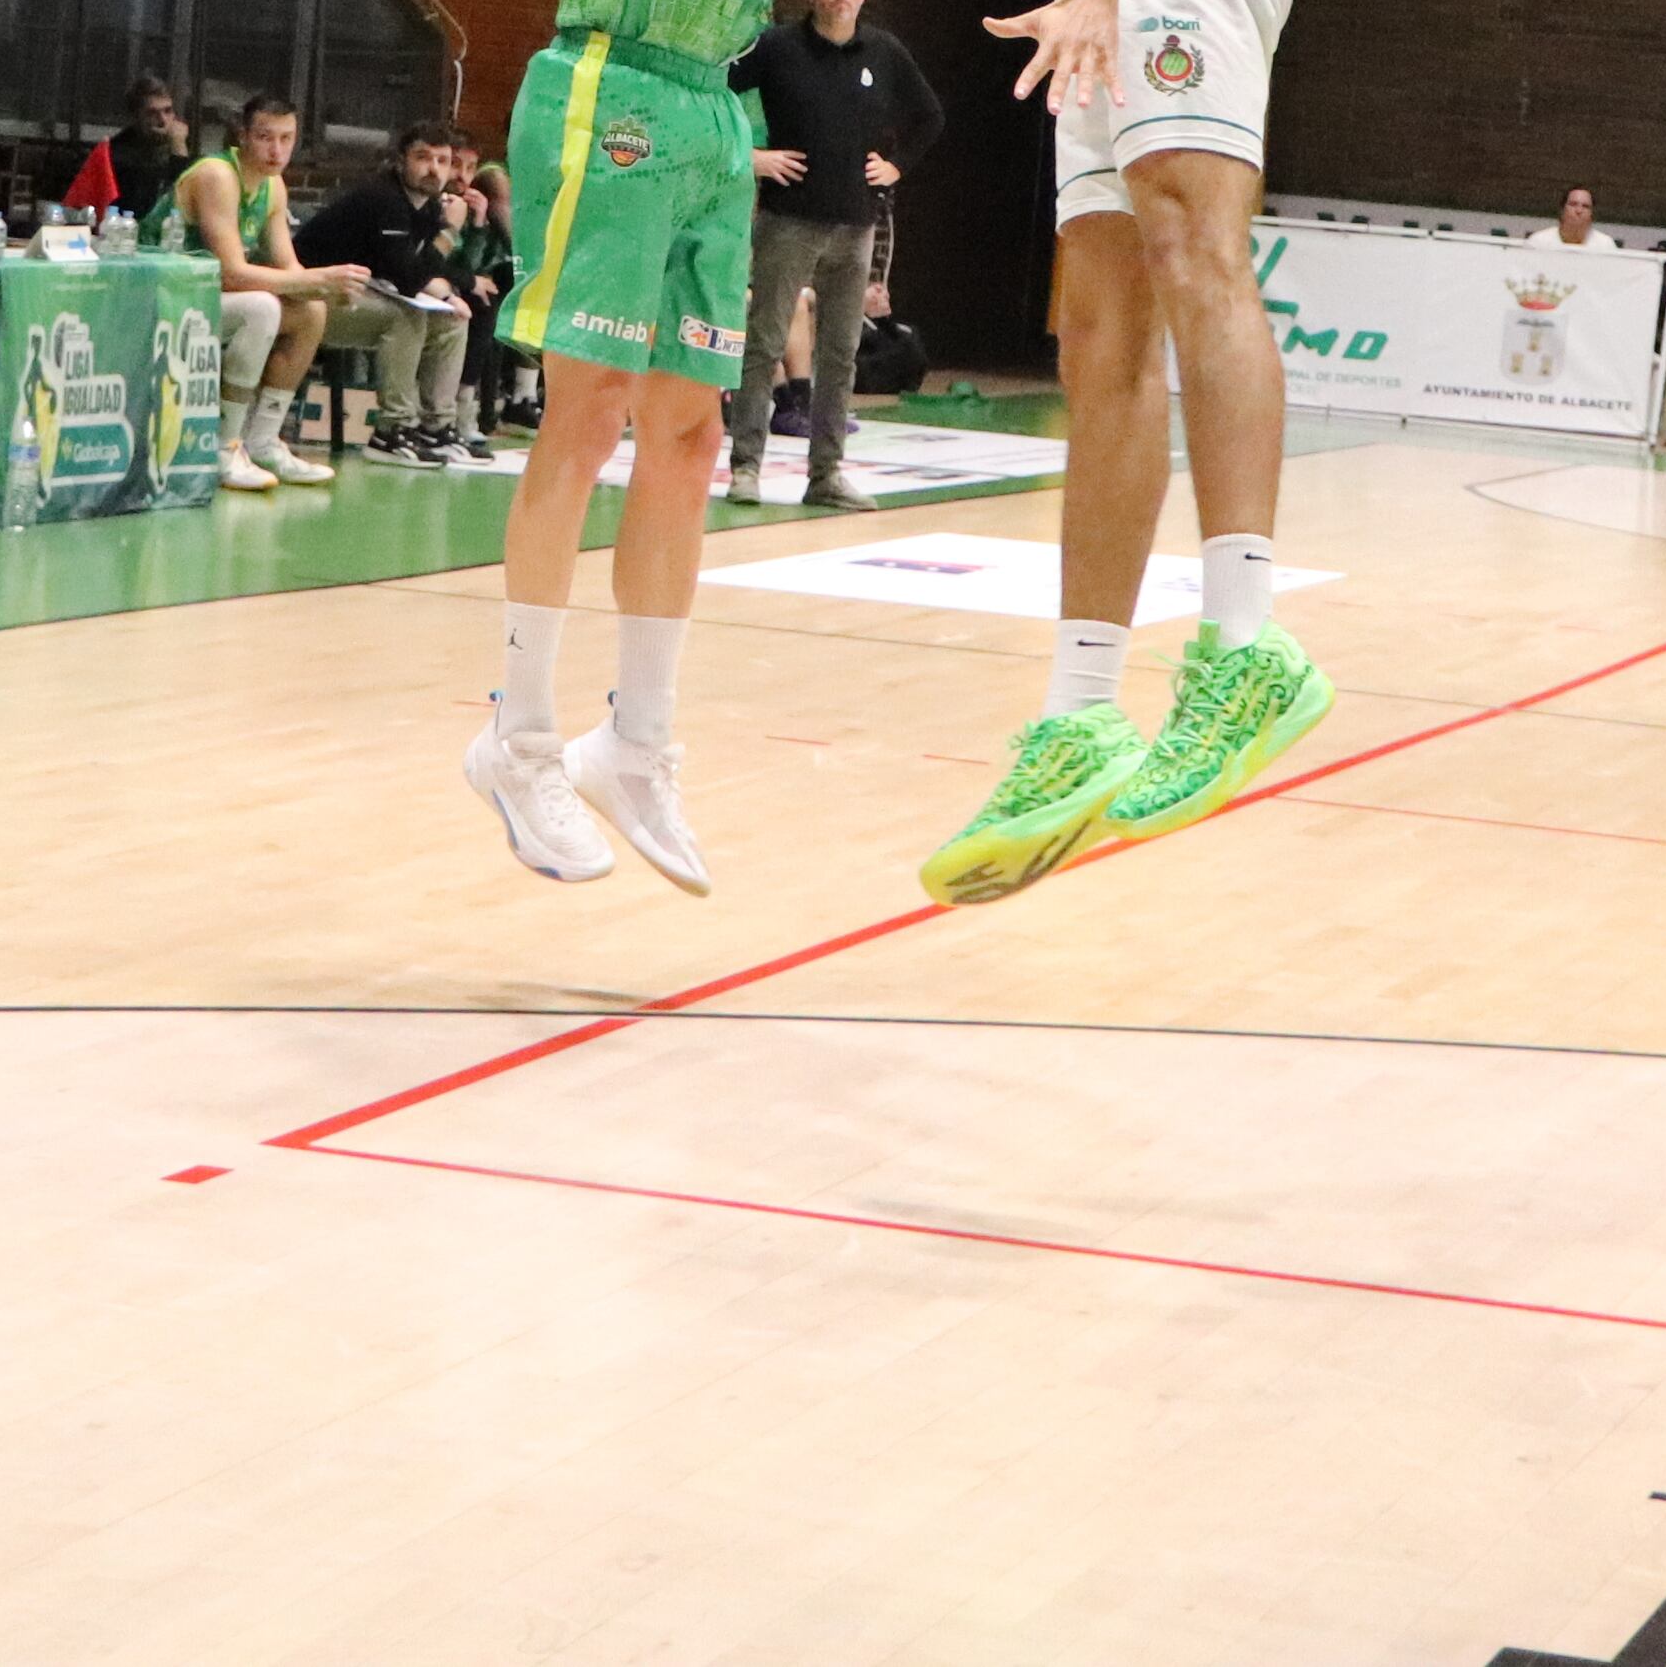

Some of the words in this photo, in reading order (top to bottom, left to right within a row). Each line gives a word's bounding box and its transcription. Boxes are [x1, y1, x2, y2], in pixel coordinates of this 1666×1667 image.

[604, 133, 649, 152] ALBACETE
[571, 310, 649, 345] amiab
[1335, 373, 1402, 388] DEPORTES
[64, 384, 121, 415] IGUALDAD
[1423, 384, 1534, 403] AYUNTAMIENTO
[1538, 394, 1555, 406] DE
[1561, 396, 1634, 412] ALBACETE
